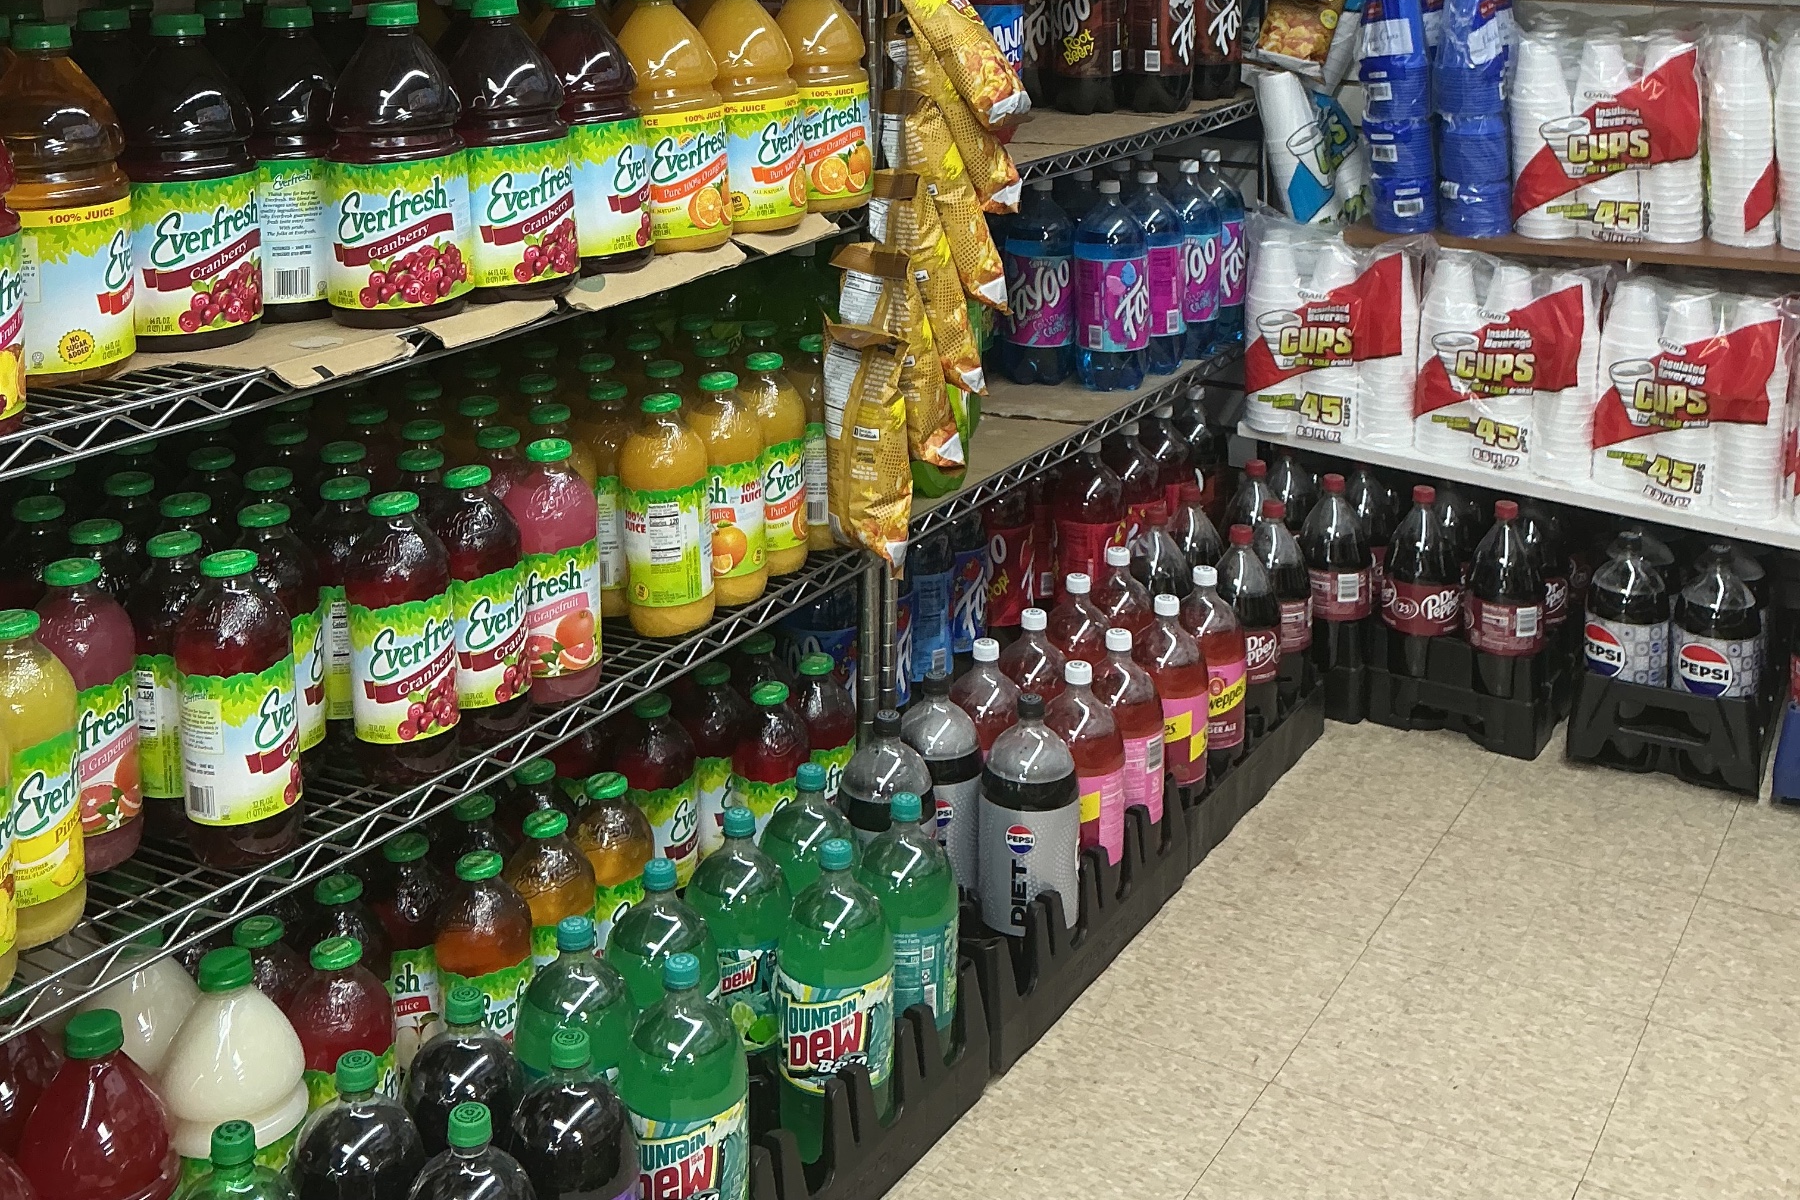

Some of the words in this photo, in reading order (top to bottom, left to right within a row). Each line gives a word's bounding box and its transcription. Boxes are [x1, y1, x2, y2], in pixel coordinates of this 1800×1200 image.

[1063, 29, 1095, 52] Root
[1063, 41, 1095, 67] Beer!
[811, 89, 832, 99] 100%
[834, 87, 855, 97] JUICE
[684, 115, 705, 124] 100%
[706, 111, 722, 120] JUICE
[741, 104, 766, 113] JUICE
[826, 136, 849, 153] Orange
[849, 129, 863, 144] Juice
[1567, 129, 1651, 164] CUPS
[273, 170, 312, 191] Everfresh
[664, 186, 682, 198] Pure
[683, 176, 702, 192] 100%
[701, 165, 721, 181] Orange
[769, 169, 784, 180] Pure
[732, 196, 741, 204] NO
[764, 186, 785, 195] NATURAL
[48, 212, 82, 225] 100%
[84, 206, 115, 221] JUICE
[337, 175, 447, 245] Everfresh
[521, 196, 569, 235] Cranberry
[1593, 200, 1642, 232] 45
[1642, 202, 1651, 233] CUPS
[151, 191, 259, 269] Everfresh
[367, 224, 430, 259] Cranberry
[189, 239, 249, 281] Cranberry
[66, 341, 87, 352] SUGAR
[69, 336, 80, 344] NO
[1279, 325, 1354, 357] CUPS
[68, 346, 90, 360] ADDED
[1455, 350, 1536, 383] CUPS
[1659, 357, 1708, 376] Insulated
[1657, 368, 1706, 386] Beverage
[1633, 378, 1709, 416] CUPS
[1300, 391, 1344, 426] 45
[1343, 397, 1351, 427] CUPS
[1314, 428, 1326, 440] FL
[1327, 430, 1341, 443] OZ
[1475, 417, 1521, 450] 45
[1647, 454, 1697, 493] 45
[740, 481, 761, 493] 100%
[740, 490, 762, 504] JUICE
[625, 510, 645, 523] 100%
[711, 510, 731, 521] Juice
[770, 505, 787, 518] Pure
[624, 522, 647, 534] JUICE
[669, 518, 680, 526] 120
[1439, 589, 1455, 602] Dr
[533, 598, 580, 625] Grapefruit
[1397, 602, 1410, 614] 23
[1247, 636, 1265, 649] Dr
[1680, 659, 1730, 681] PEPSI
[1224, 722, 1237, 732] ALE
[90, 731, 134, 773] Grapefruit
[1006, 833, 1035, 846] PEPSI
[24, 887, 33, 897] OZ
[1010, 858, 1029, 928] DIET
[789, 1012, 862, 1068] DEW
